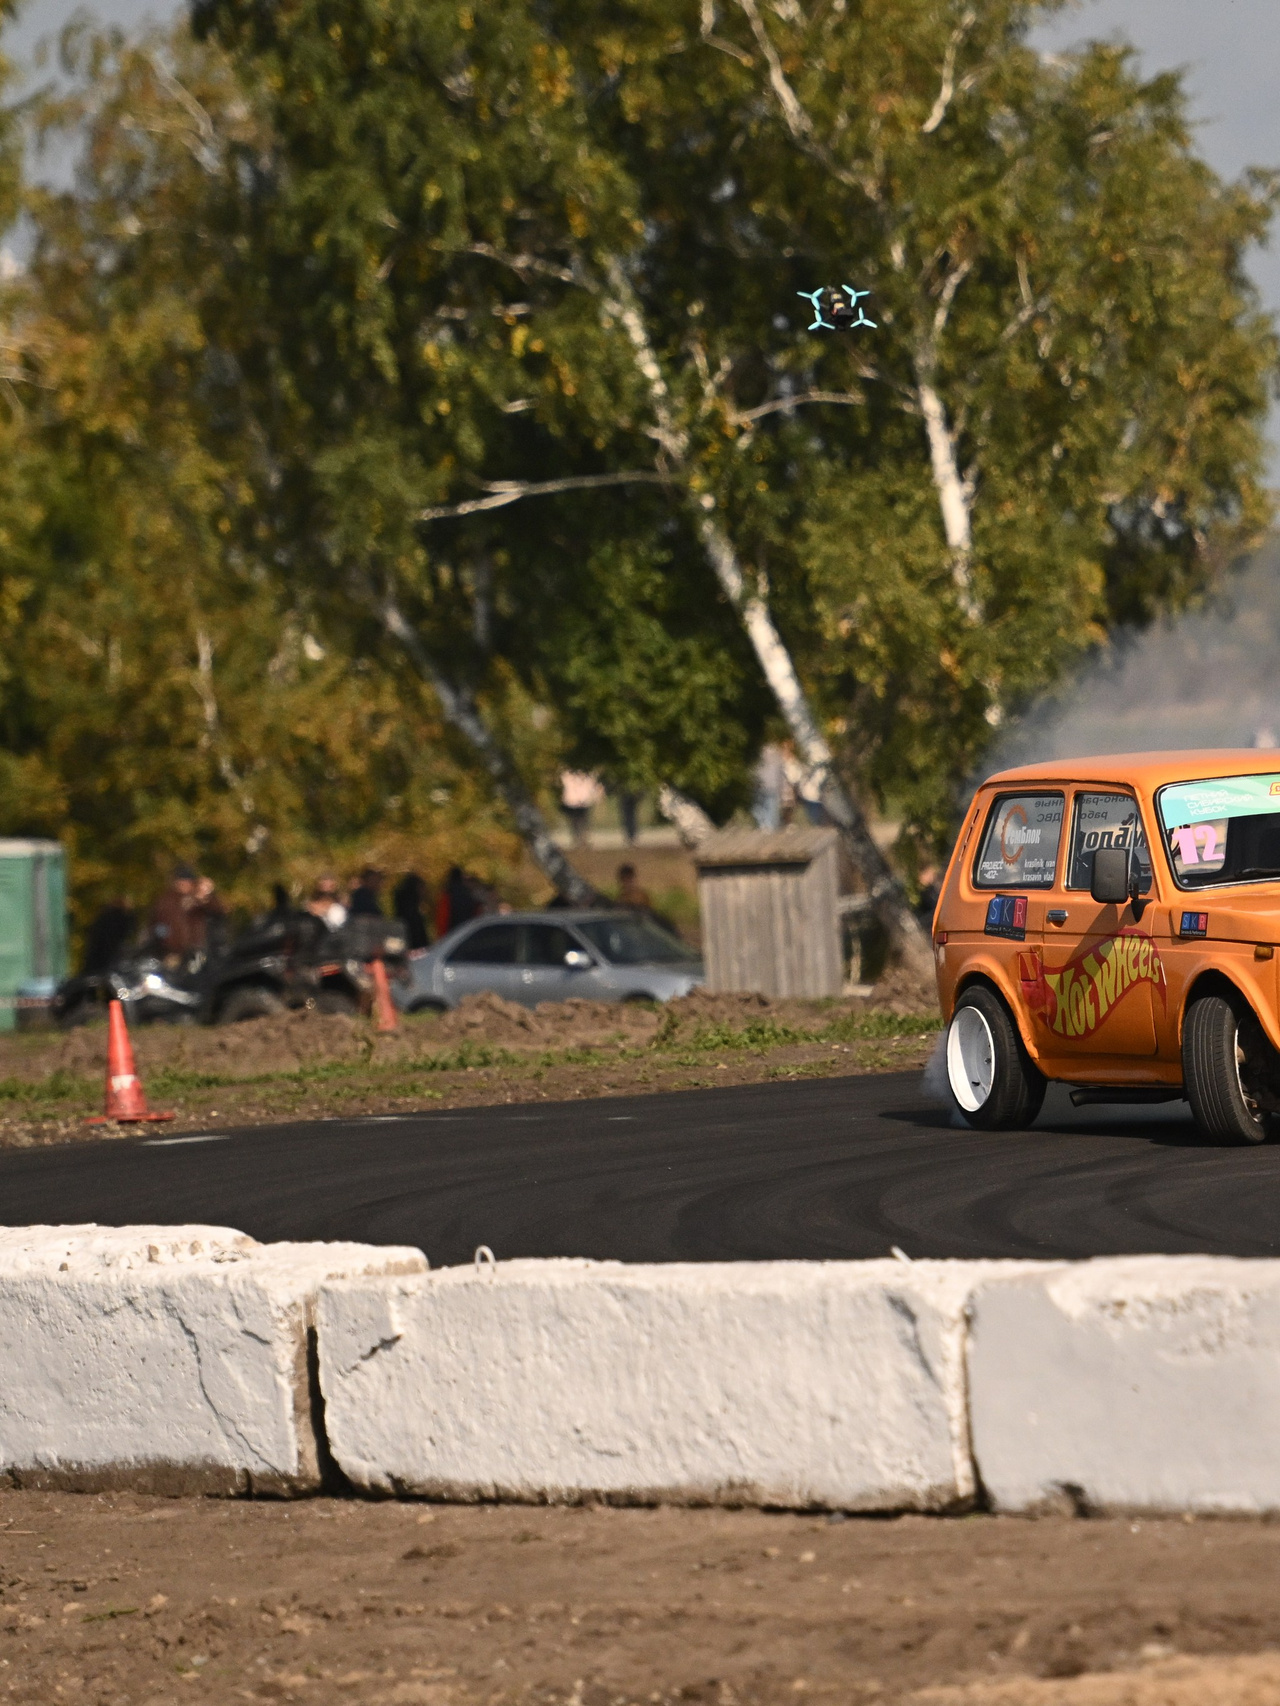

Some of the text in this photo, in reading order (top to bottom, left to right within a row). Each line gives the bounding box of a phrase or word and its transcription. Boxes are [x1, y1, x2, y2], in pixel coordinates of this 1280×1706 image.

[1189, 804, 1229, 816] КУБОК
[1172, 824, 1225, 865] 12
[990, 898, 1024, 925] SKR
[1182, 914, 1206, 928] SKR
